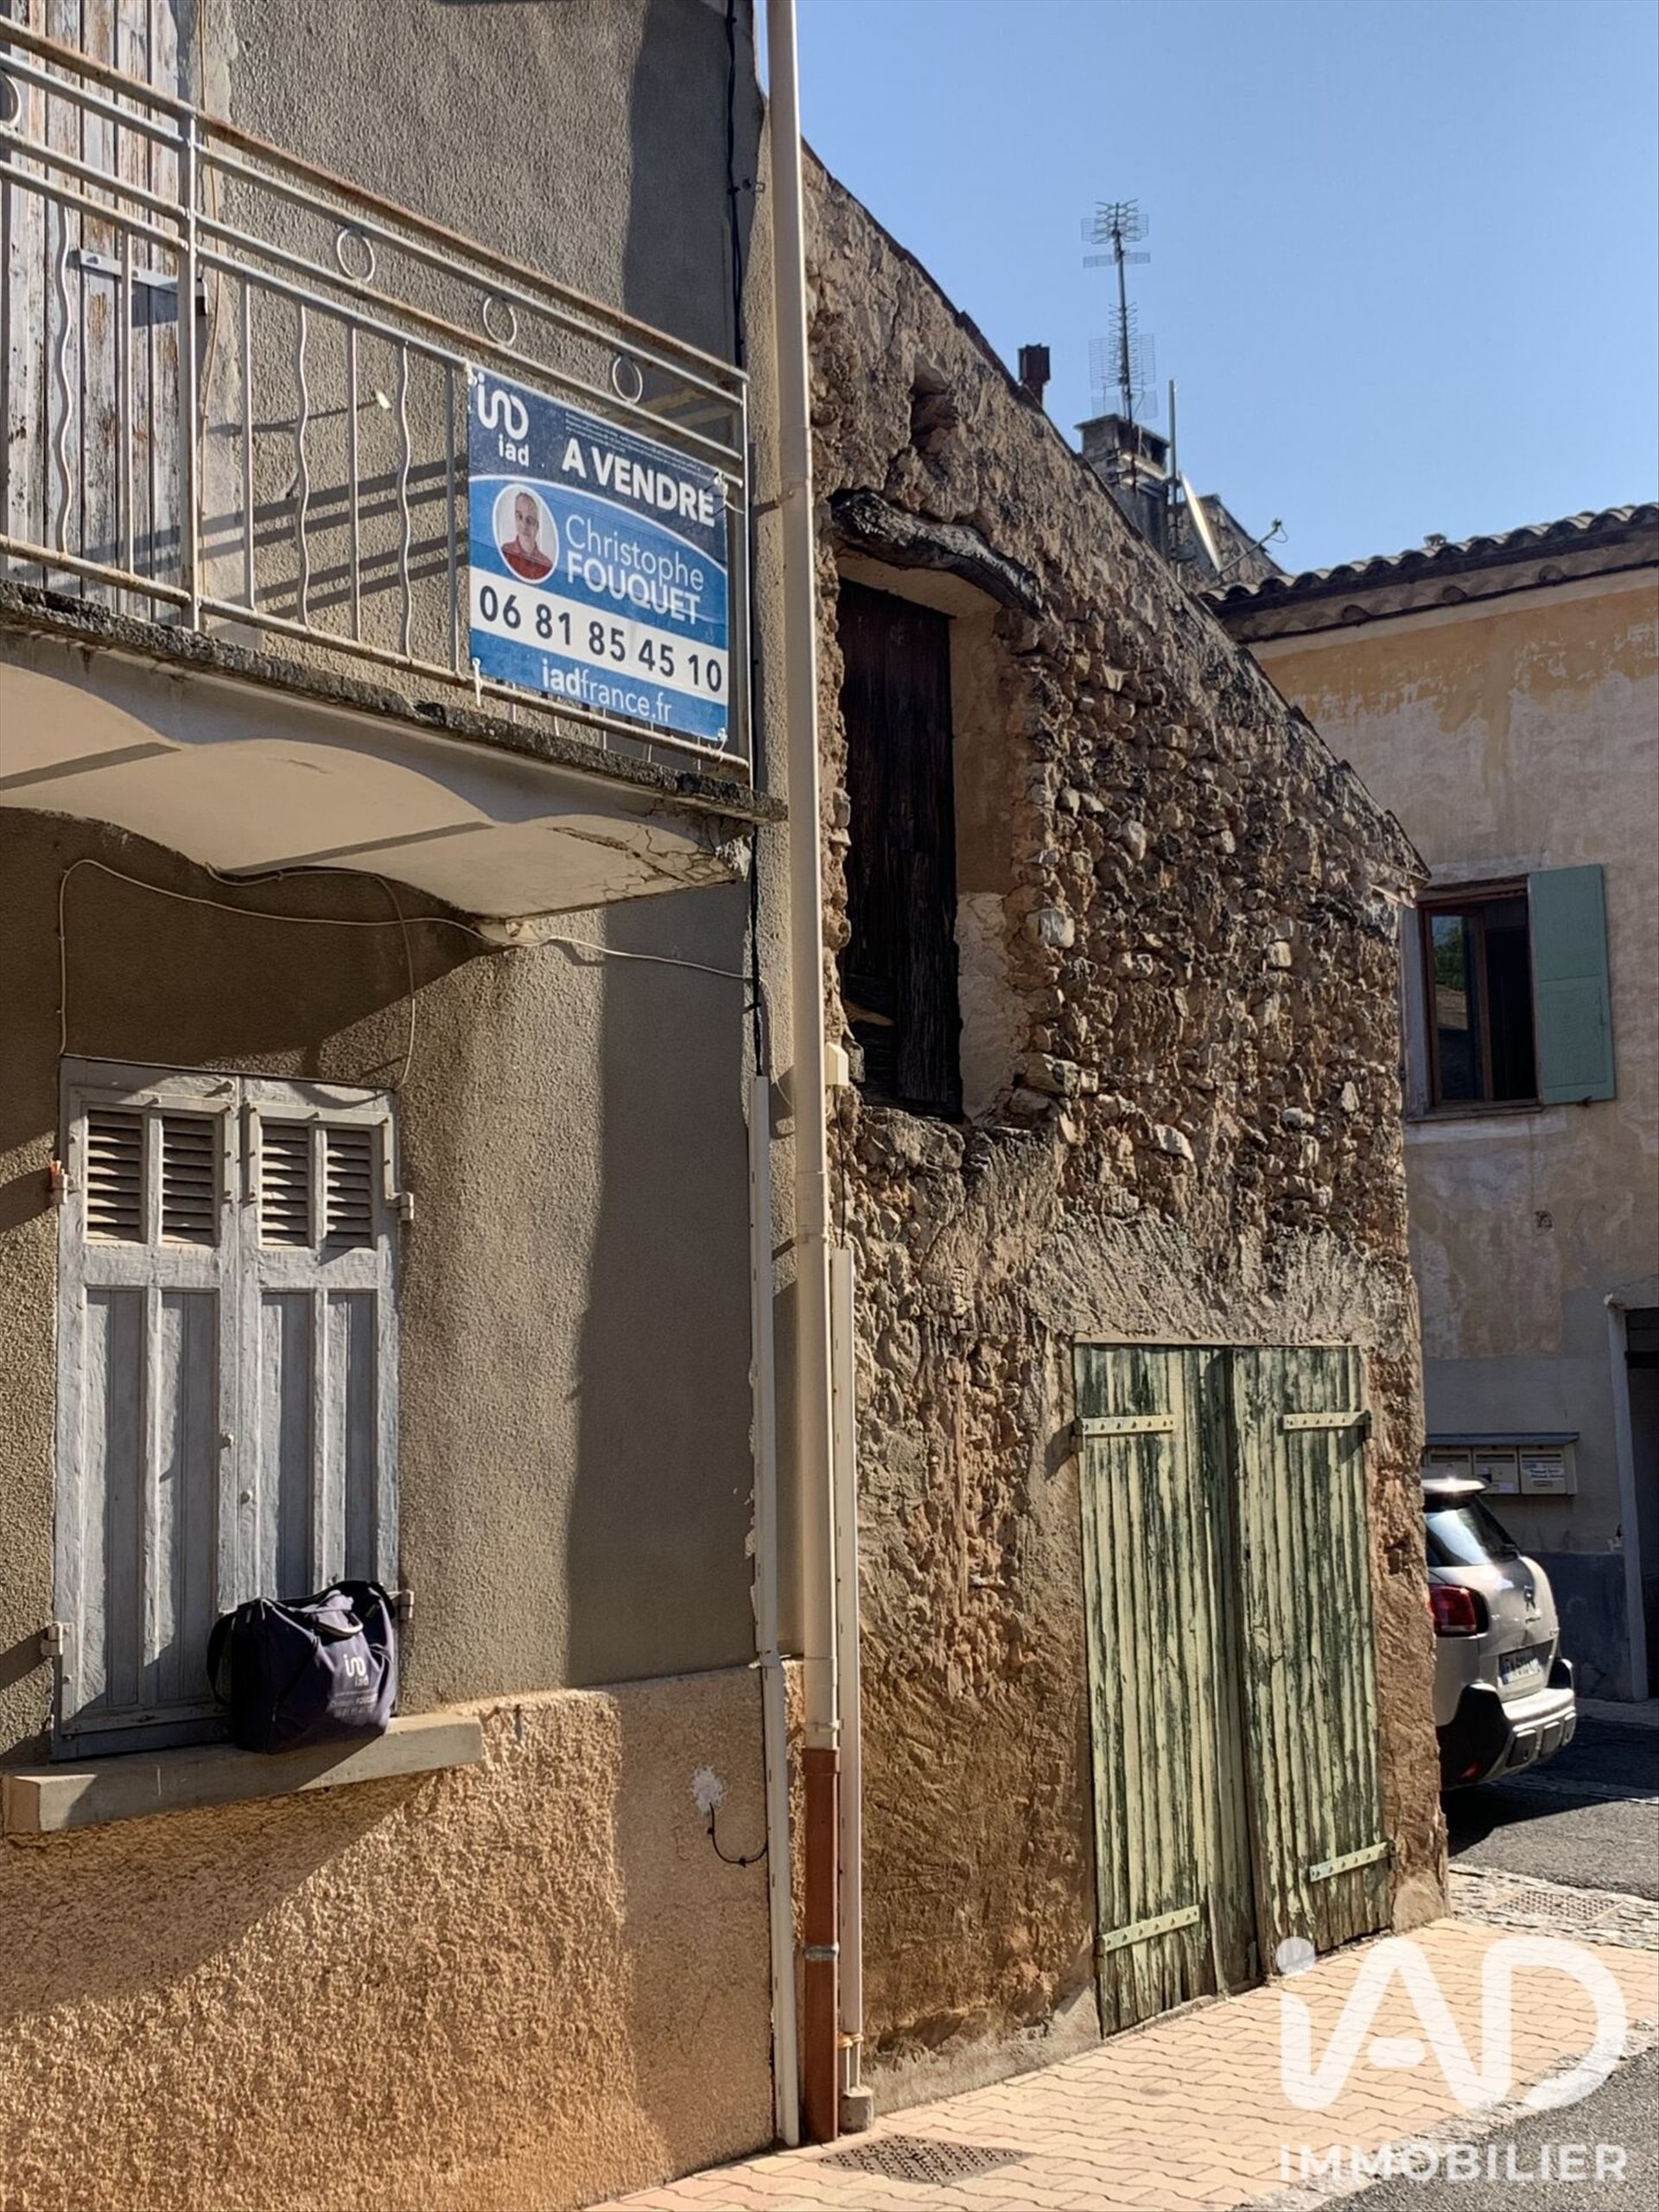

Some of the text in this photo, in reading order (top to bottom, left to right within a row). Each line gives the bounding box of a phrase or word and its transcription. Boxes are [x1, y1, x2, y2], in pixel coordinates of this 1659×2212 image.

[498, 435, 529, 467] iad
[562, 437, 587, 480] A
[591, 446, 715, 528] VENDRE
[565, 513, 704, 592] Christophe
[567, 550, 701, 625] FOUQUET
[479, 585, 722, 692] 06 81 85 45 10
[542, 658, 672, 723] iadfrance.fr
